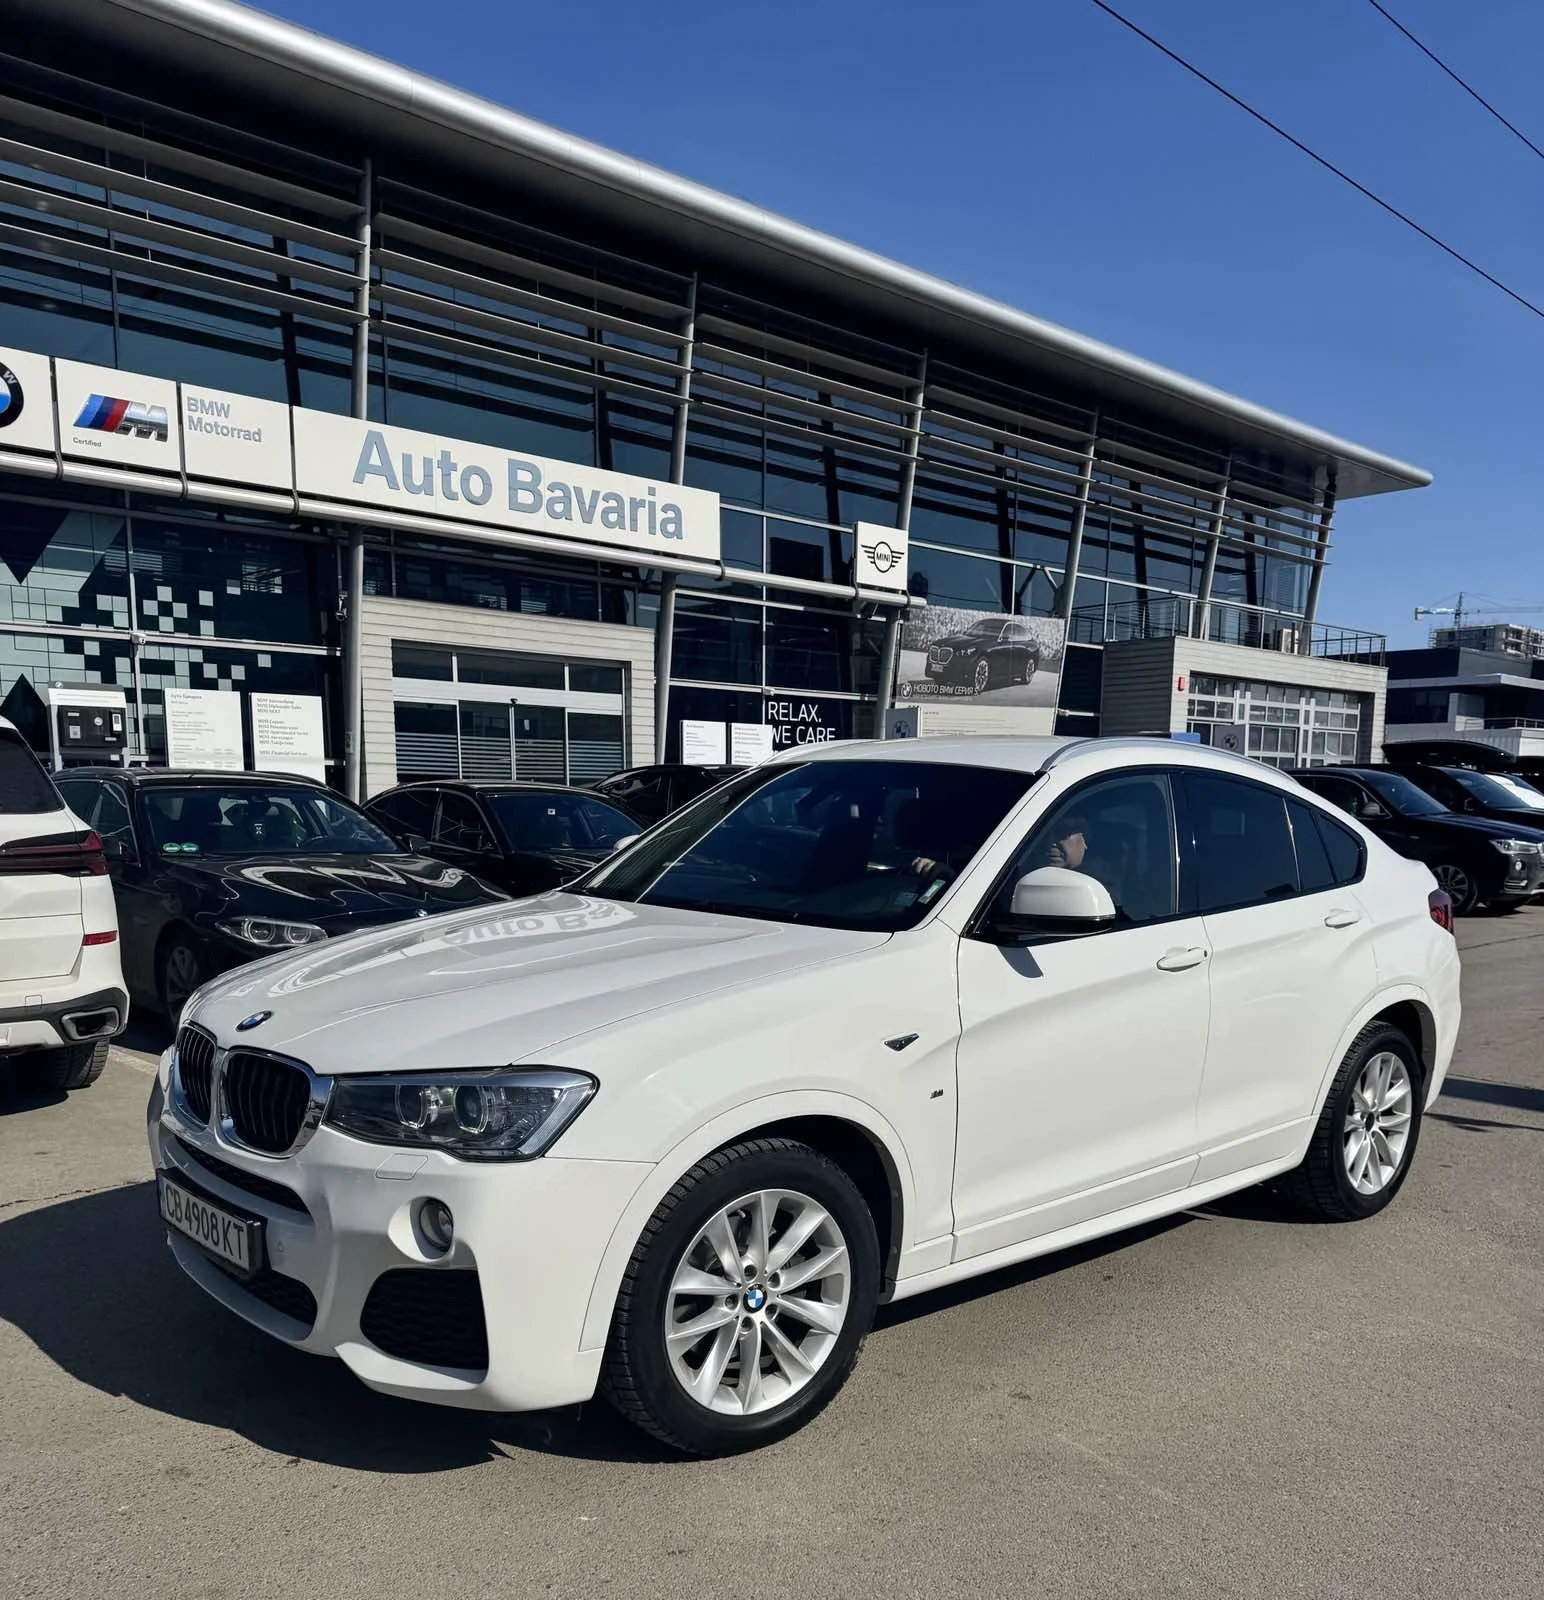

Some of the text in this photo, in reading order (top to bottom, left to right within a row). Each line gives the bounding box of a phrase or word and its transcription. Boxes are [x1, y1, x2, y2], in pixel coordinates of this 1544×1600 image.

[186, 396, 231, 419] BMW
[187, 416, 262, 443] Motorrad
[72, 436, 103, 448] Certified
[352, 429, 684, 540] Auto Bavaria
[876, 552, 891, 562] MINI
[768, 701, 822, 723] RELAX.
[772, 725, 792, 744] WE
[796, 726, 836, 745] CARE
